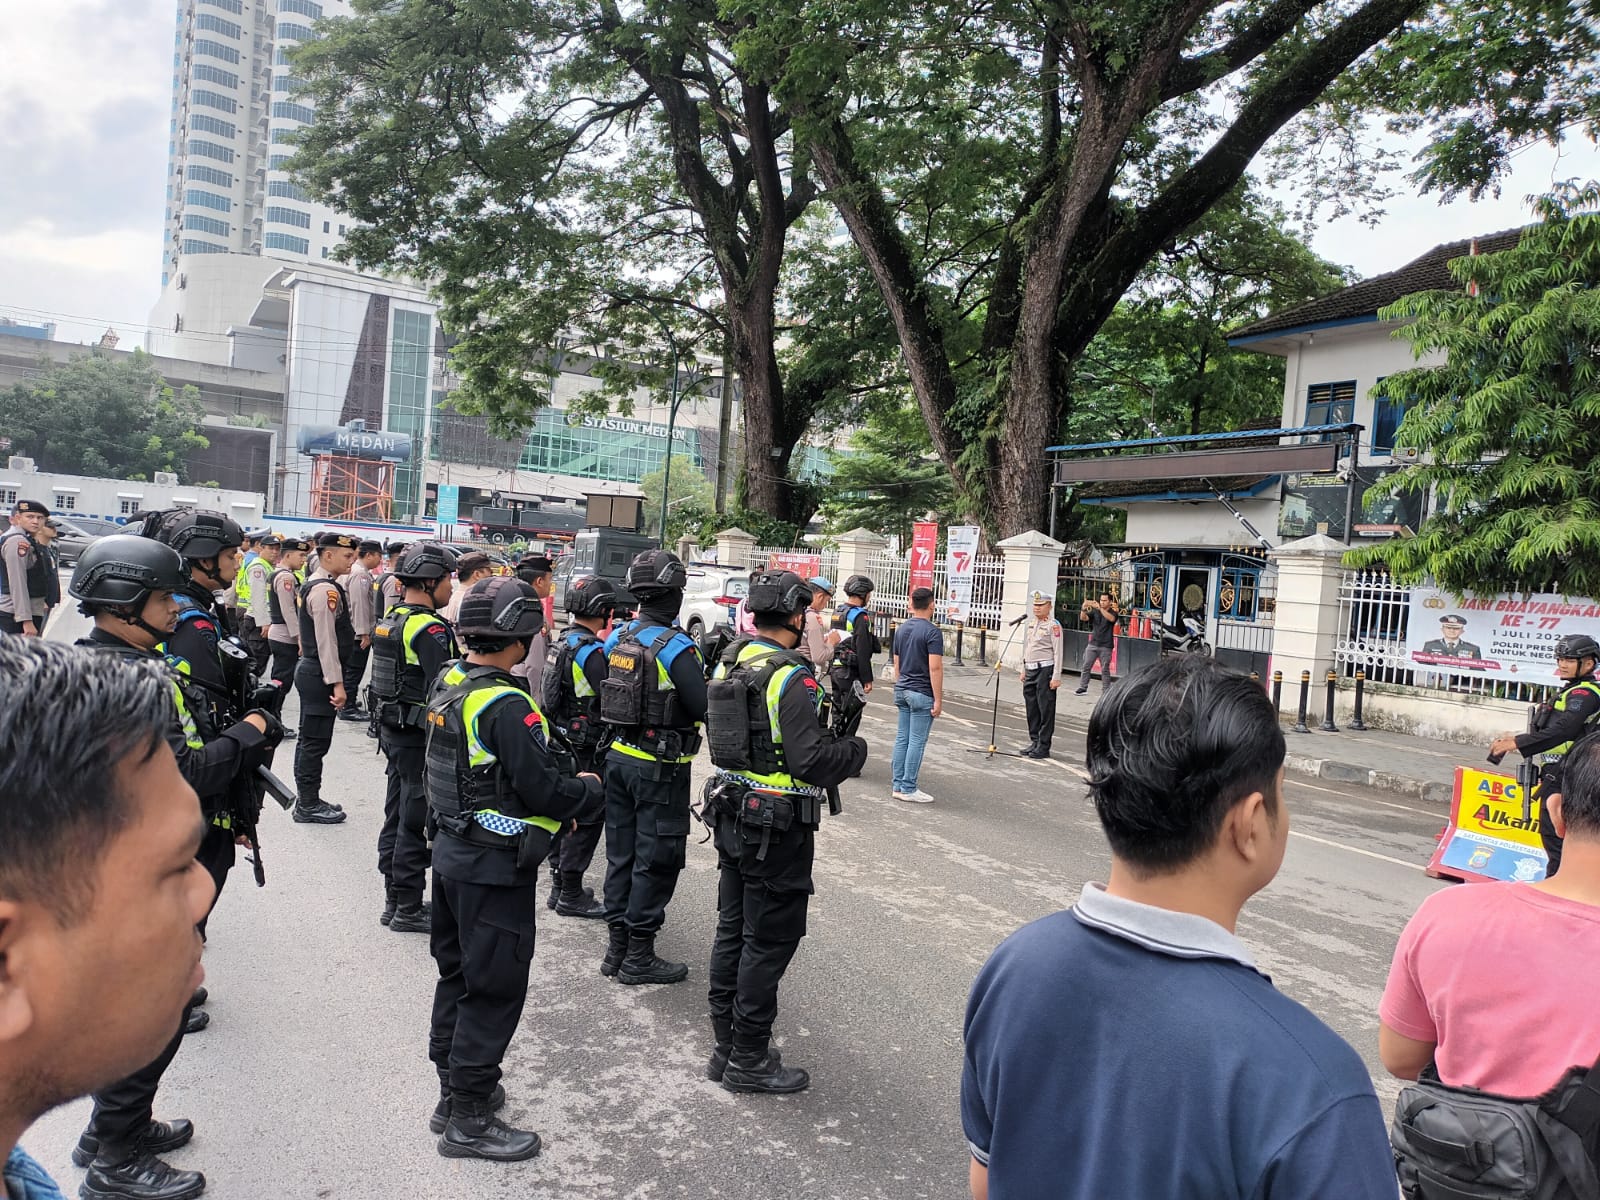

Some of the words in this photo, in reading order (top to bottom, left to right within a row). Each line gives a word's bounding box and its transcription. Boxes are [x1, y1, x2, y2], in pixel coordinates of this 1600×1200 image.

[583, 416, 639, 433] STASIUN
[642, 424, 685, 440] MEDAN
[337, 434, 395, 451] MEDAN
[1300, 476, 1345, 486] PRESIS
[1458, 598, 1492, 611] HARI
[1500, 614, 1524, 627] KE
[1538, 617, 1561, 630] 77
[1502, 630, 1530, 639] JULI
[1536, 632, 1563, 642] 202
[1490, 648, 1526, 657] UNTUK
[1492, 641, 1522, 649] POLRI
[1526, 644, 1554, 652] PRES
[1478, 779, 1516, 798] ABC
